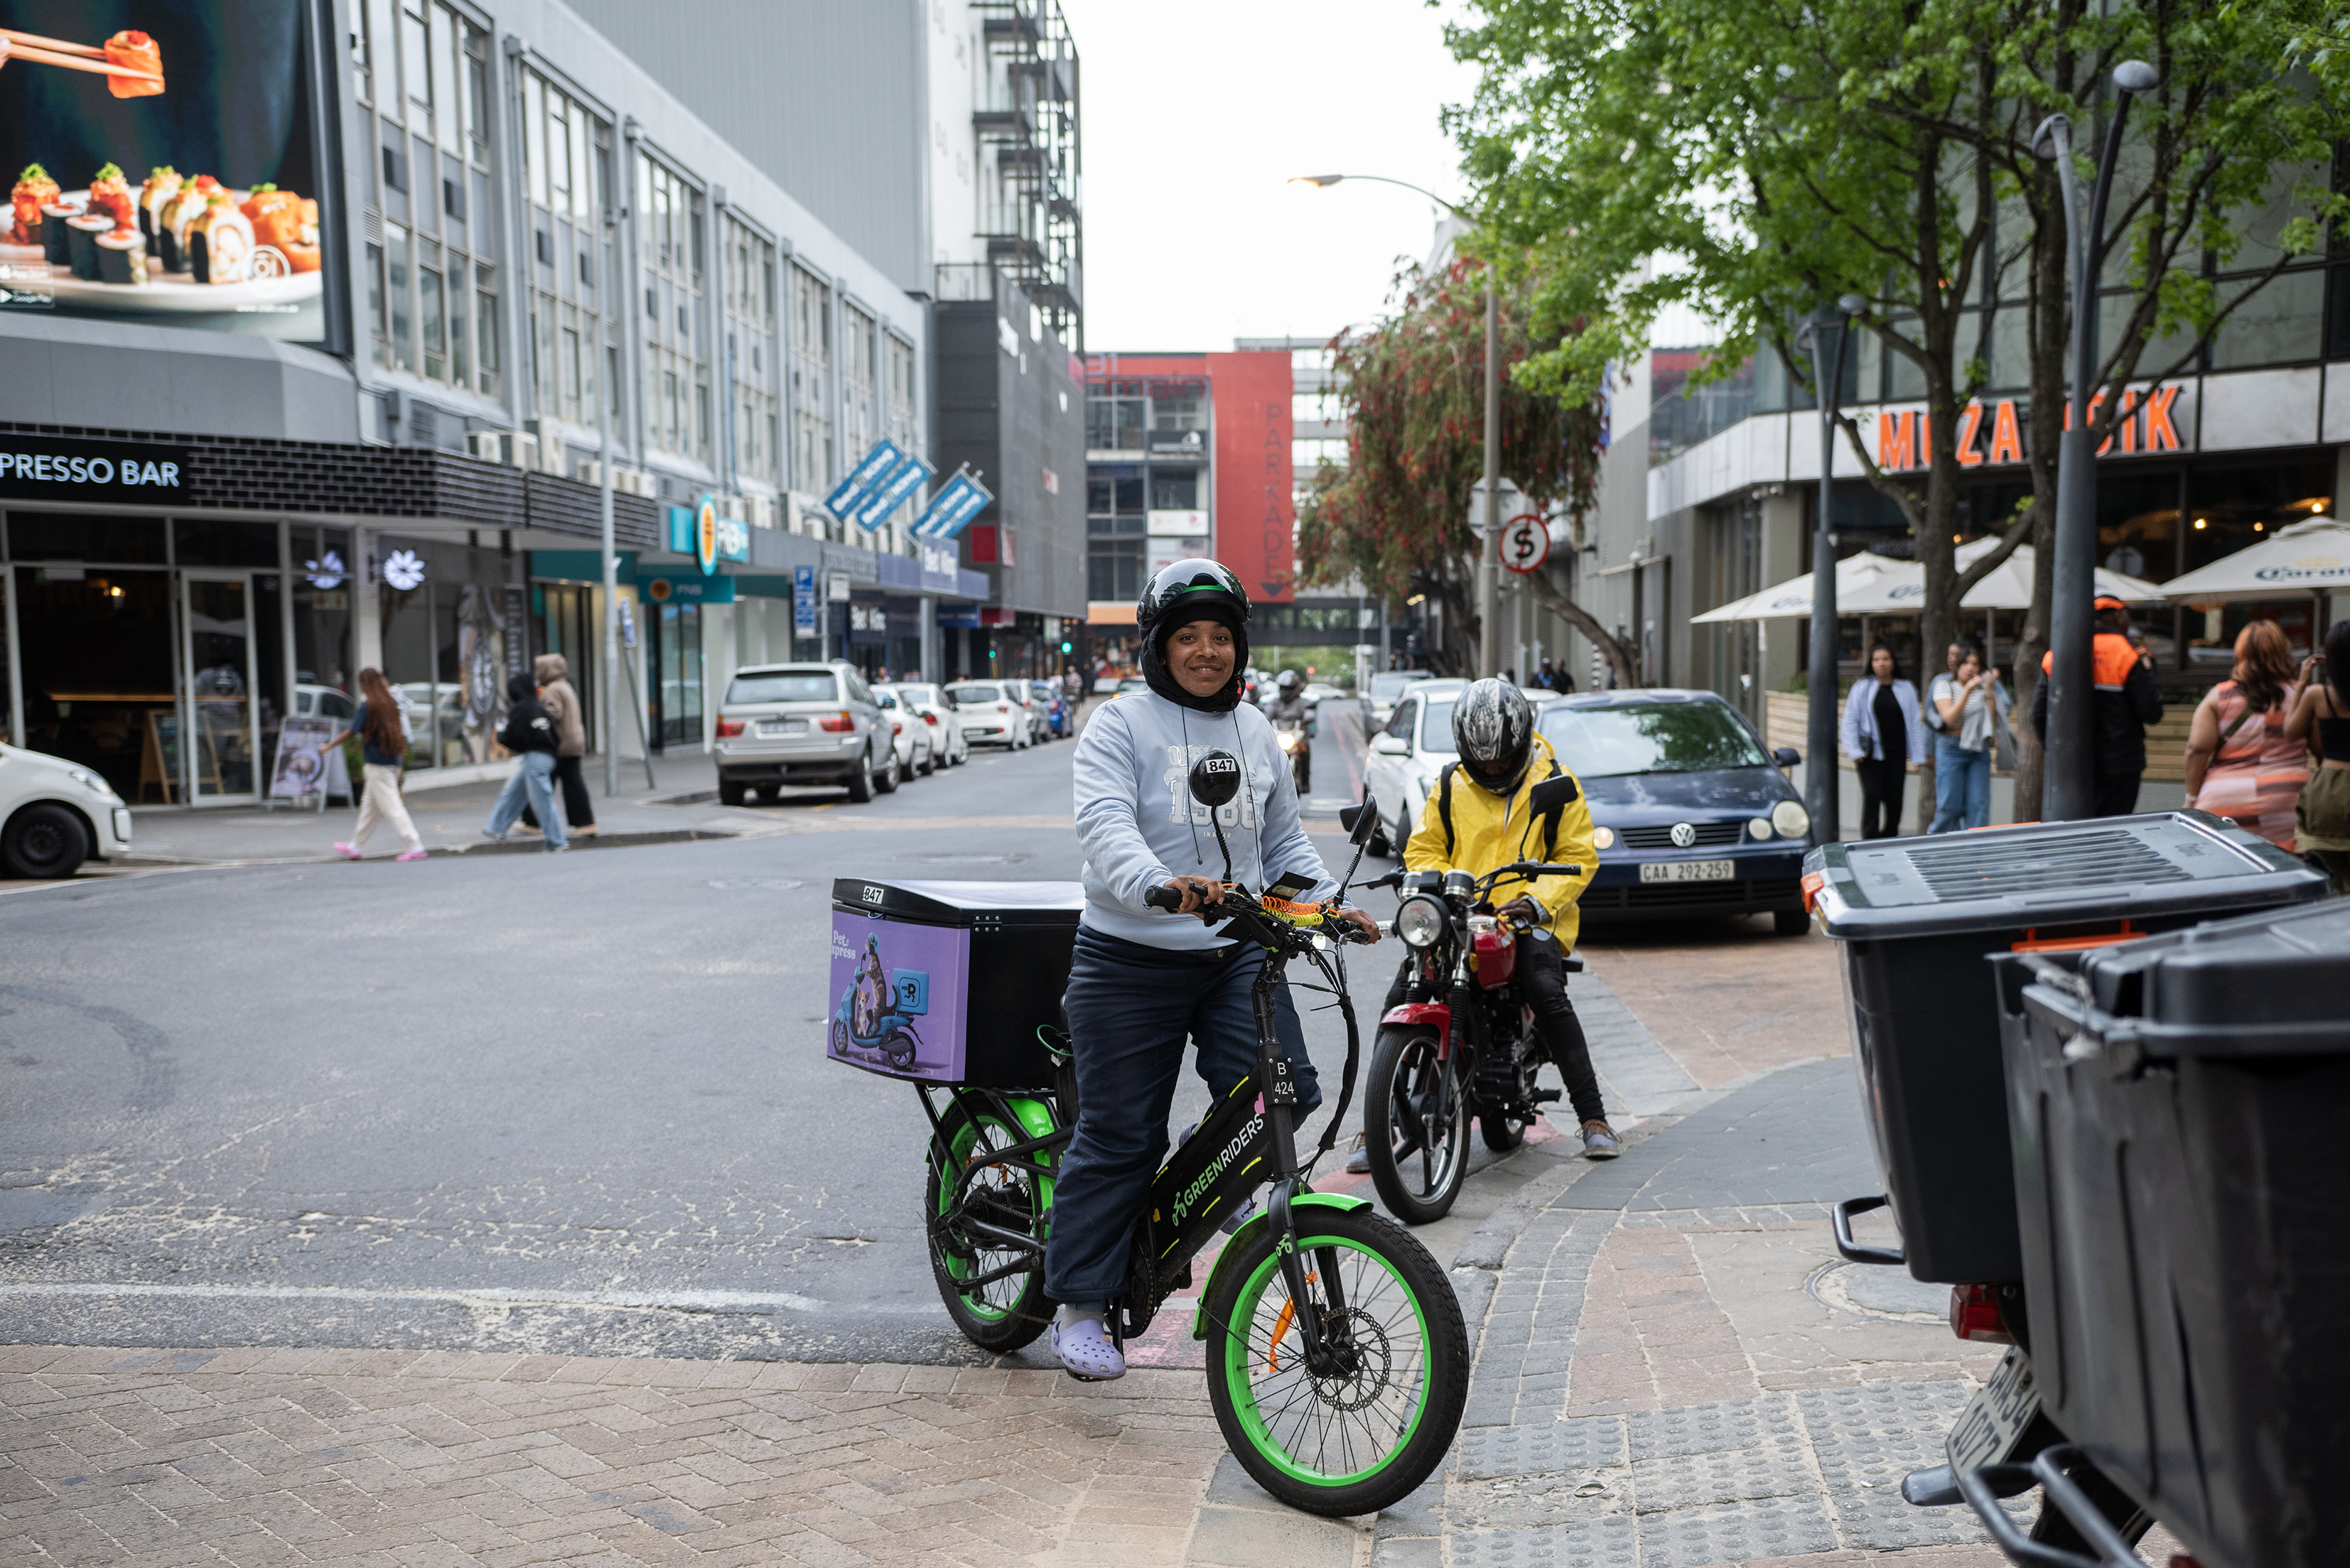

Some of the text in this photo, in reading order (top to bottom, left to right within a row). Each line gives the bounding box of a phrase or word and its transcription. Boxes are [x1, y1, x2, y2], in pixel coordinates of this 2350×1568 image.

[0, 453, 180, 487] PRESSO BAR
[1263, 402, 1285, 580] PARKADE
[1209, 760, 1233, 772] 847
[1644, 866, 1669, 881] CAA
[864, 888, 882, 902] 847
[833, 930, 847, 946] Pet
[1277, 1062, 1287, 1076] B
[1274, 1081, 1295, 1095] 424
[1953, 1402, 2001, 1469] 1077
